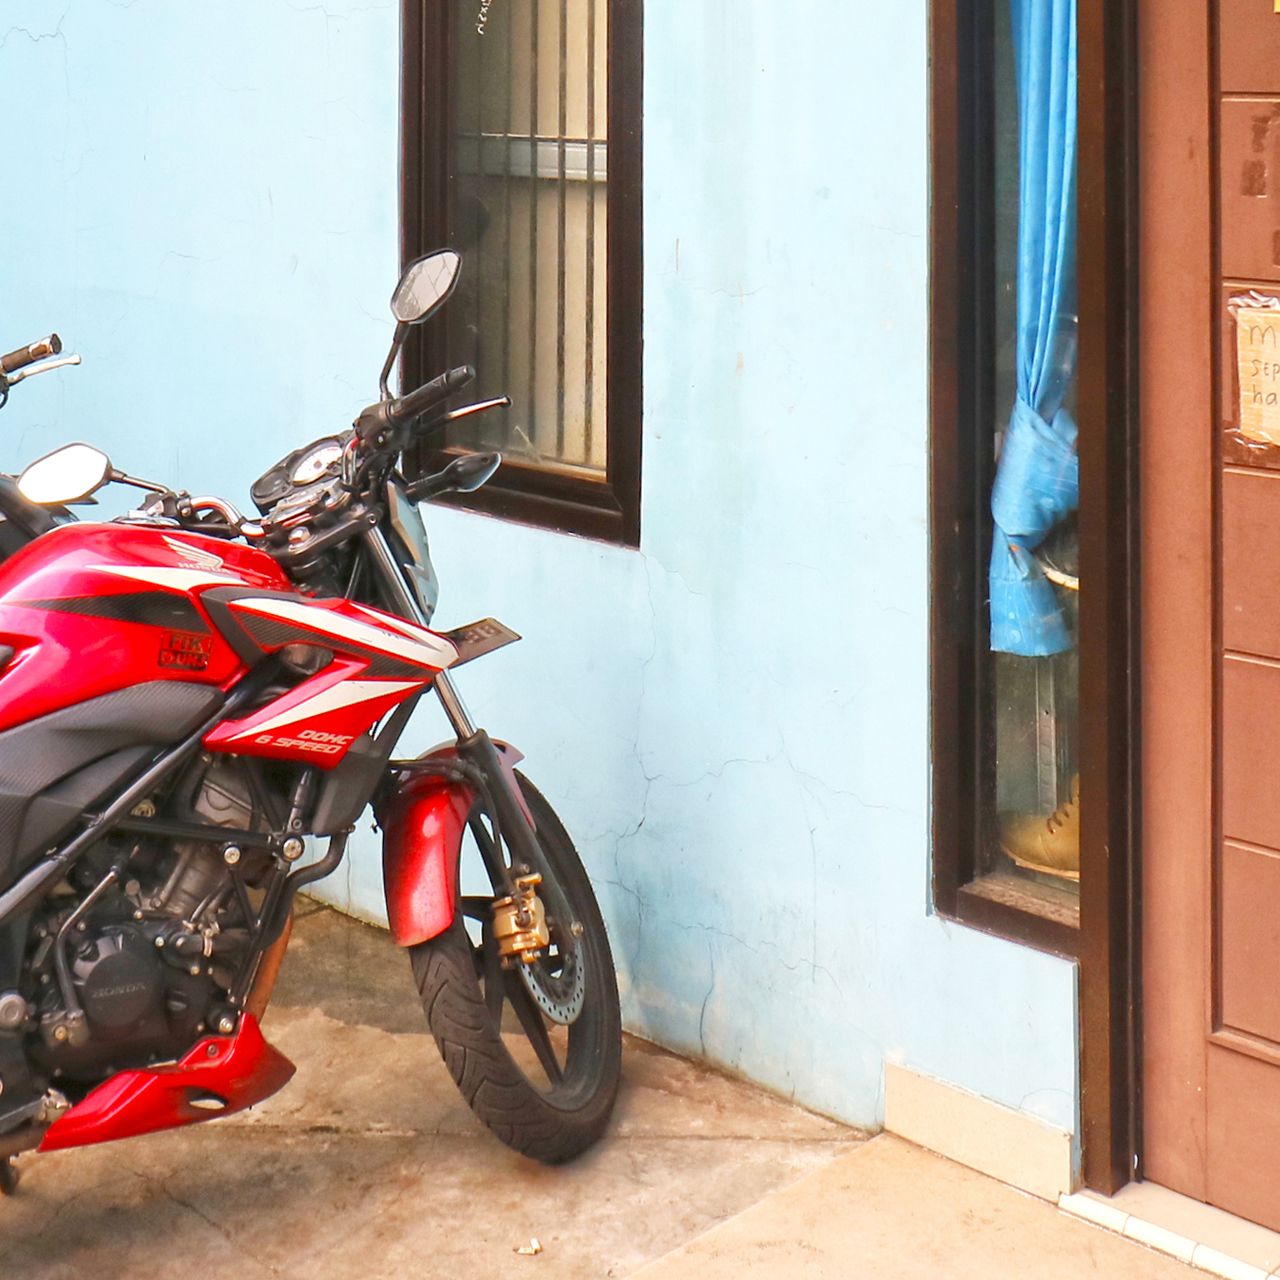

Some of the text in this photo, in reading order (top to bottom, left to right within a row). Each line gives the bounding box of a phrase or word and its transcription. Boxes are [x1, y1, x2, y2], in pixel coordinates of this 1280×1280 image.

[254, 734, 342, 754] 6 SPEED
[297, 730, 354, 745] DOHC
